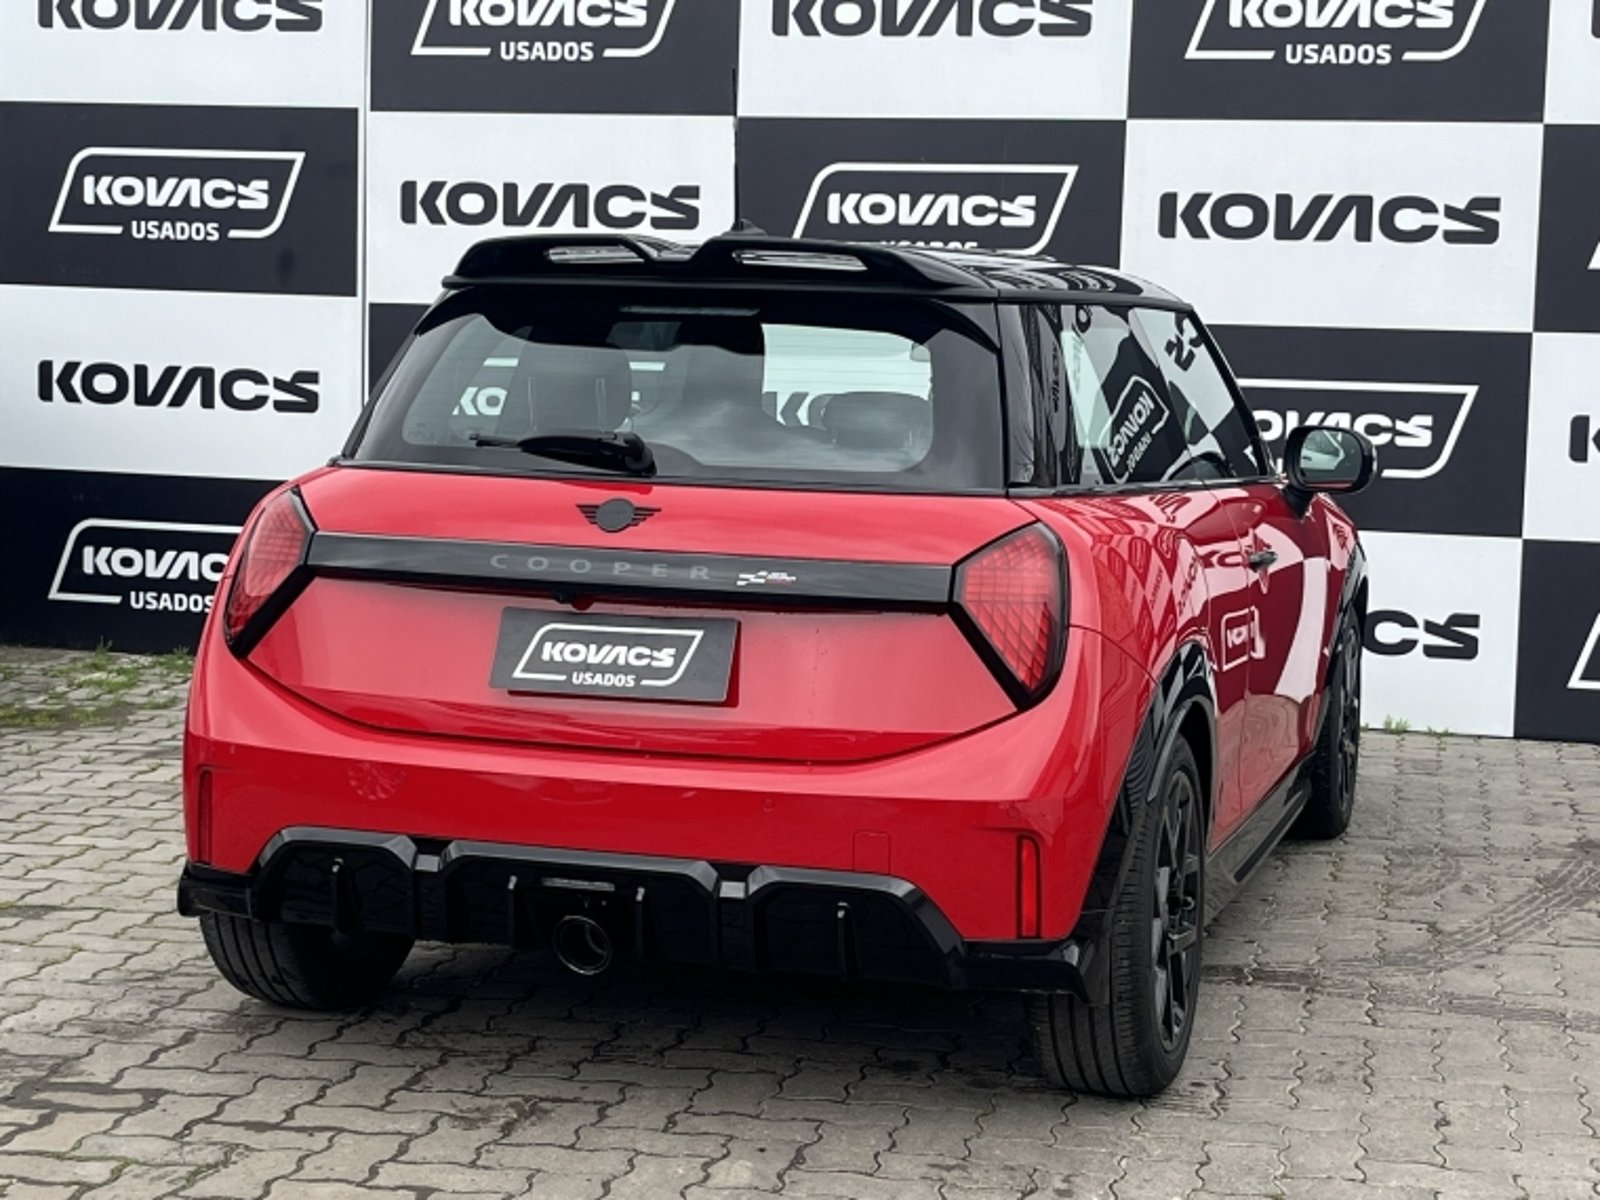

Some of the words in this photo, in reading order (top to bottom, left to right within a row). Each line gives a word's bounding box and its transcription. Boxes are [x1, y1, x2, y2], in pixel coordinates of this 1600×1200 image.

[37, 0, 323, 32] KOVACS
[449, 0, 648, 27] KOVACS
[772, 0, 1093, 37] KOVACS
[1228, 0, 1454, 28] KOVACS
[500, 41, 594, 61] USADOS
[1285, 43, 1392, 65] USADOS
[83, 175, 269, 210] KOVACS
[400, 180, 700, 230] KOVACS
[826, 193, 1036, 227] KOVACS
[1158, 191, 1501, 245] KOVACS
[131, 220, 220, 241] USADOS
[38, 359, 320, 413] KOVACS
[82, 544, 231, 582] KOVAC
[490, 554, 710, 580] COOPER
[541, 642, 676, 669] KOVACS
[572, 671, 636, 688] USADOS
